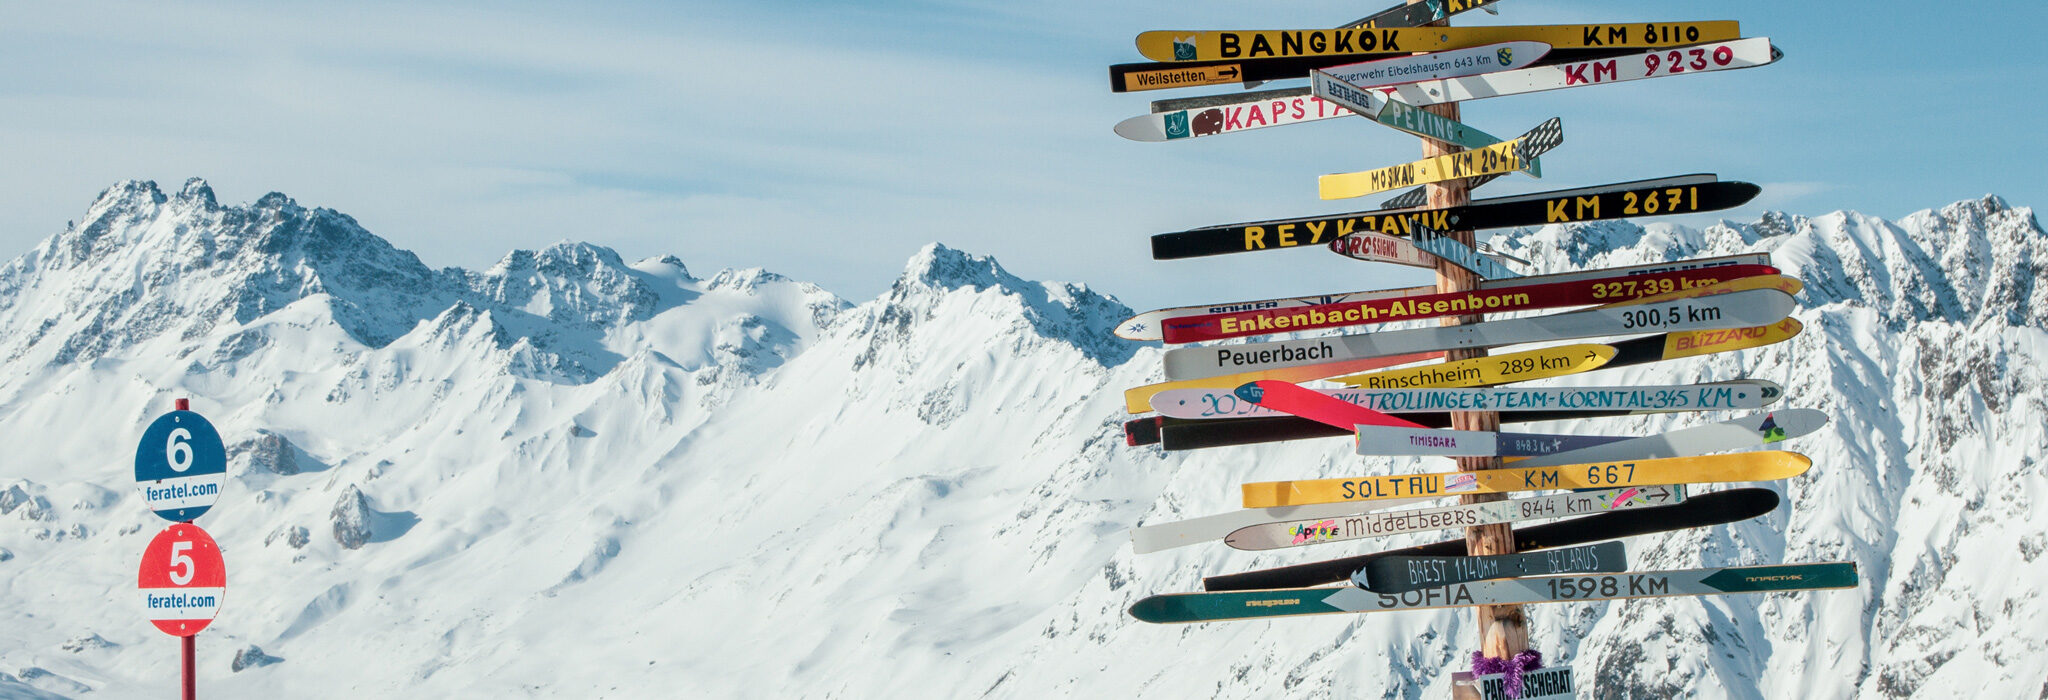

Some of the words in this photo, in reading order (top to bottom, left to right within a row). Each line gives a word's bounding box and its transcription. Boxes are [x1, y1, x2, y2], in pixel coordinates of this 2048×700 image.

[1220, 30, 1401, 58] BANGKOK
[1583, 26, 1627, 46] KM
[1644, 23, 1699, 44] 8110
[1136, 71, 1206, 86] Weilstetten
[1388, 61, 1451, 77] Eibelshausen
[1454, 56, 1473, 68] 643
[1476, 55, 1491, 65] Km
[1565, 59, 1617, 86] KM
[1644, 46, 1733, 77] 9230
[1392, 101, 1454, 140] PEKING
[1371, 164, 1415, 191] MOSKAU
[1452, 153, 1473, 178] KM
[1547, 195, 1600, 223] KM
[1624, 187, 1698, 215] 2671
[1221, 292, 1530, 334] Enkenbach-Alsenborn
[1592, 278, 1675, 299] 327,39
[1217, 342, 1333, 367] Peuerbach
[1622, 307, 1680, 329] 300,5
[1688, 306, 1721, 323] km
[1369, 366, 1481, 389] Rinschheim
[1500, 358, 1535, 375] 289
[1540, 355, 1571, 370] km
[1697, 387, 1737, 408] KM
[166, 427, 194, 473] 6
[146, 482, 218, 502] feratel.com
[1342, 475, 1437, 499] SOLTAU
[1525, 470, 1558, 488] KM
[1588, 464, 1636, 484] 667
[1567, 496, 1592, 513] km
[169, 541, 195, 586] 5
[1408, 560, 1446, 585] BREST
[1547, 546, 1599, 573] BELARUS
[147, 592, 216, 609] feratel.com
[1378, 584, 1474, 608] SOFIA
[1547, 576, 1618, 600] 1598
[1628, 575, 1669, 596] KM
